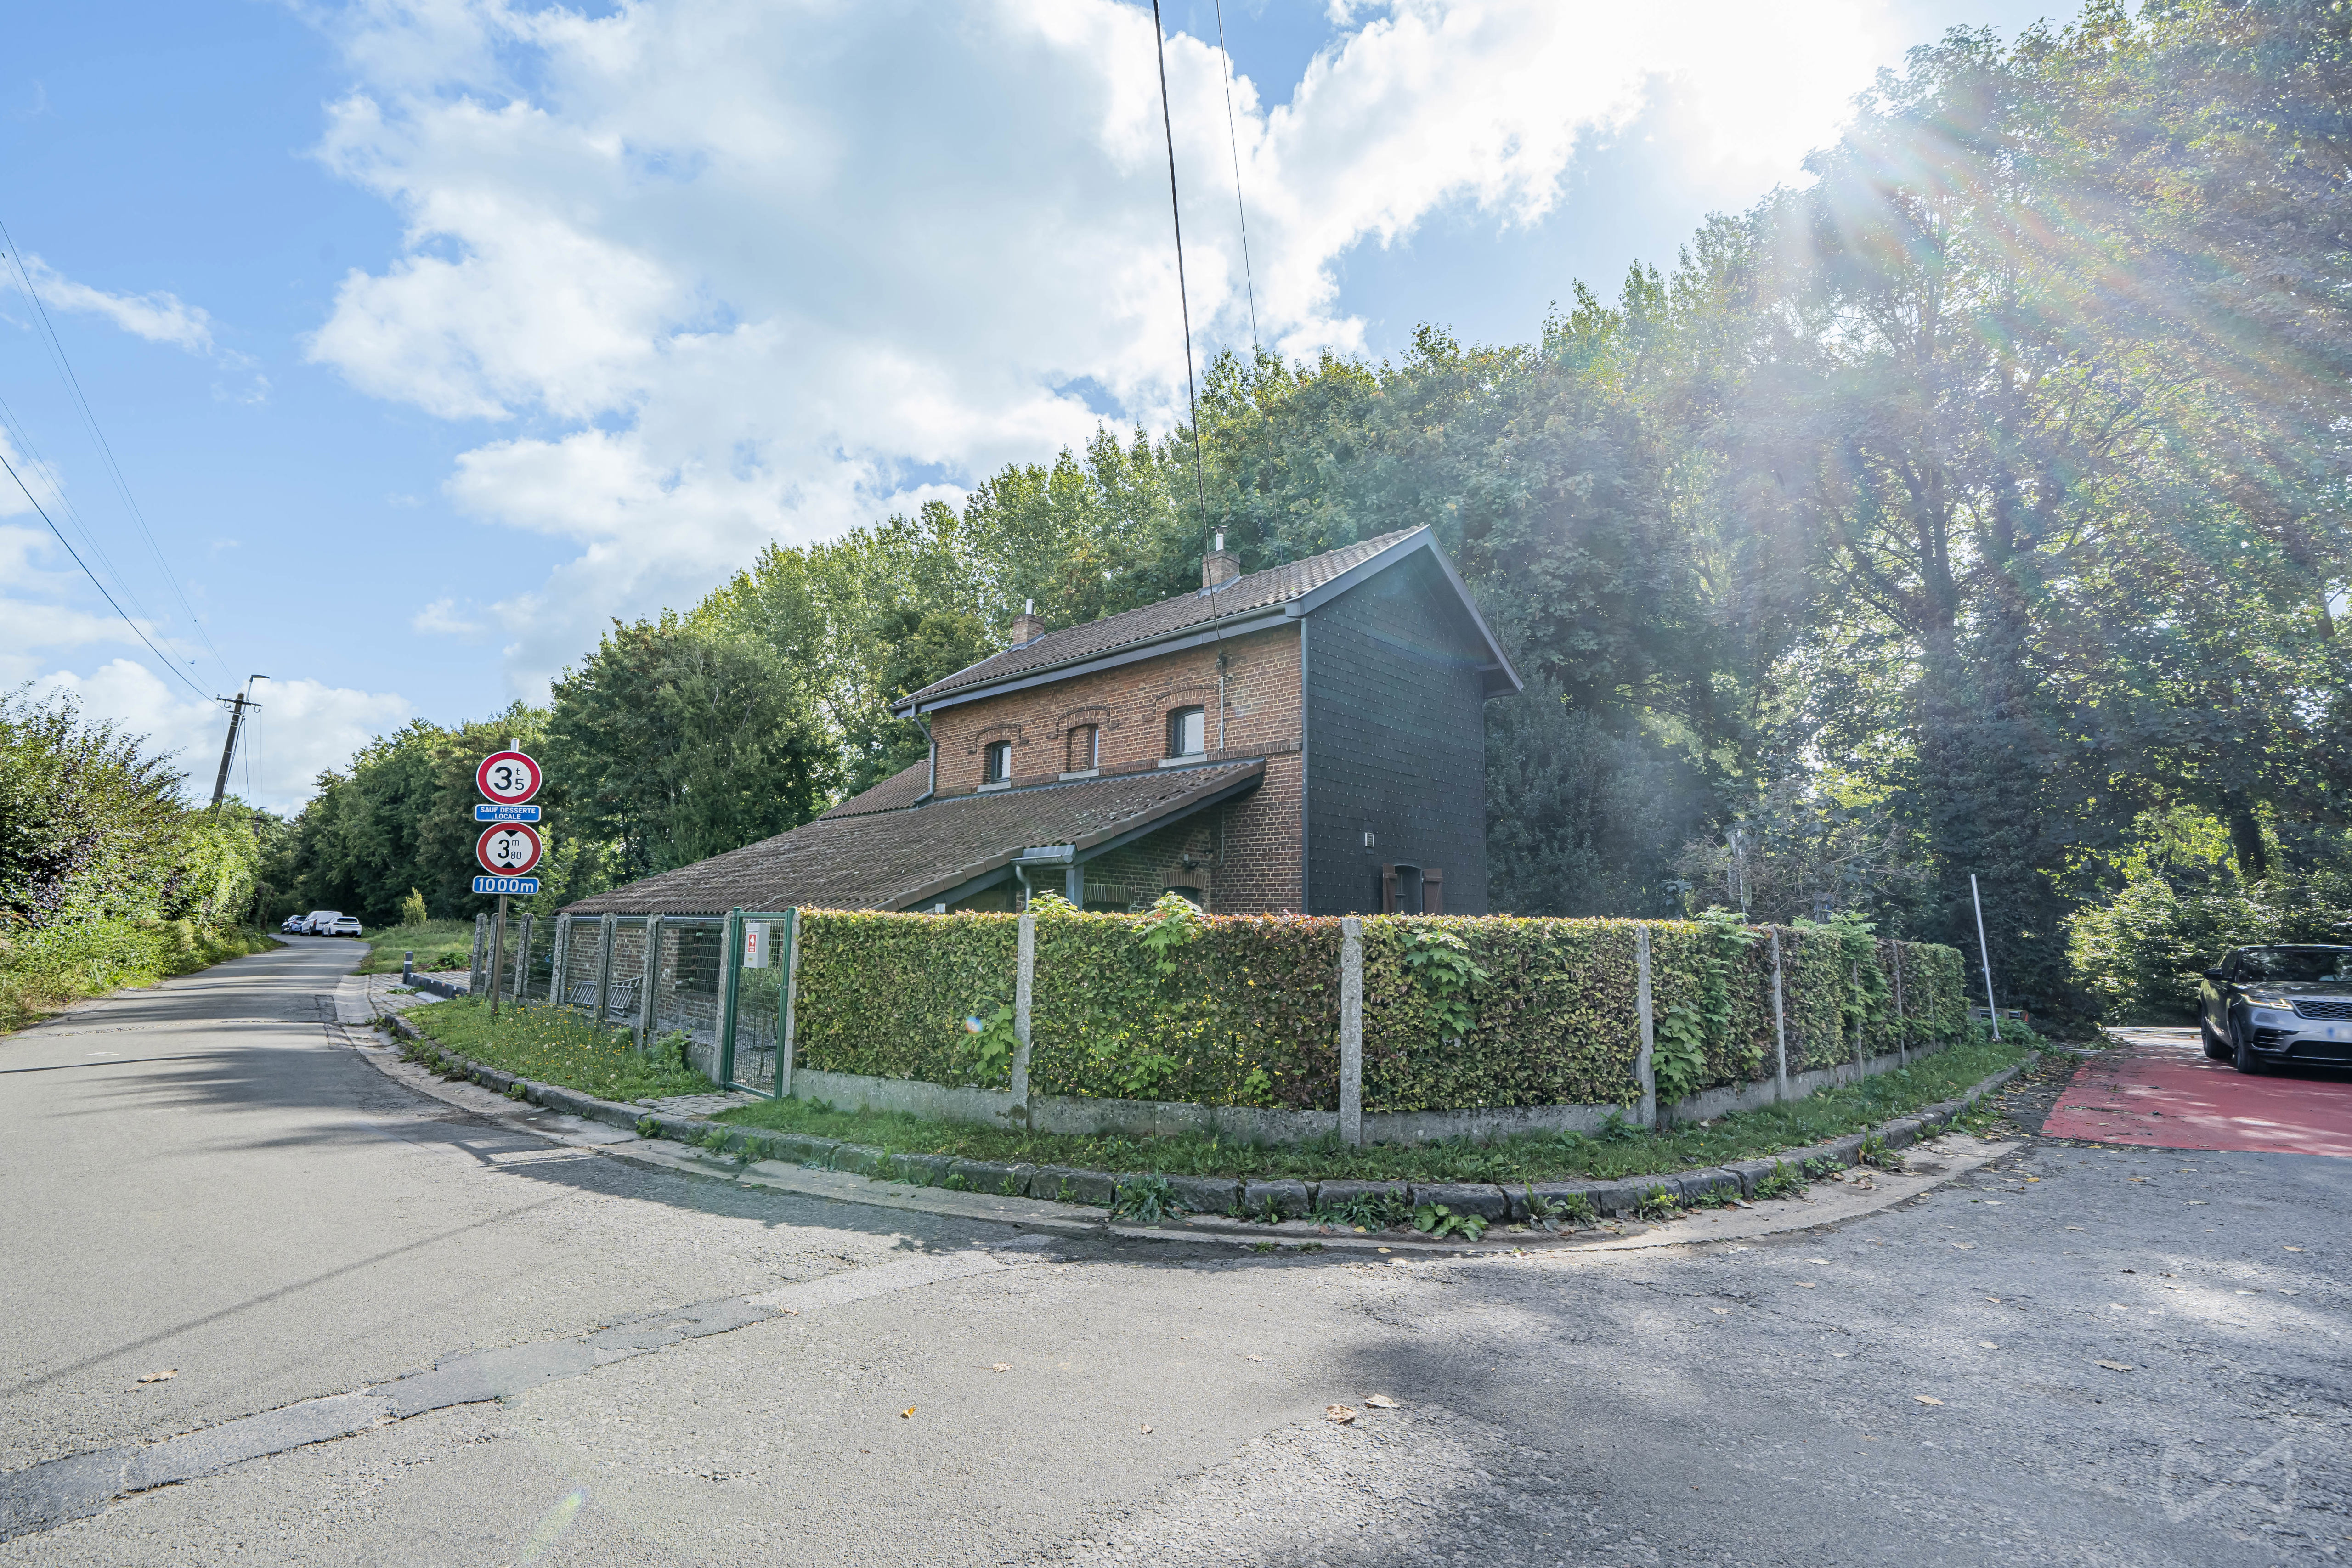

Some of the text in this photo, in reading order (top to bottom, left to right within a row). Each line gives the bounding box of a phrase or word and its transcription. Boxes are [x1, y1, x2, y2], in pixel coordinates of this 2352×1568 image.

[494, 767, 512, 790] 3
[515, 778, 524, 790] 5
[498, 839, 510, 859] 3
[511, 851, 522, 859] 80
[479, 878, 534, 892] 1000m
